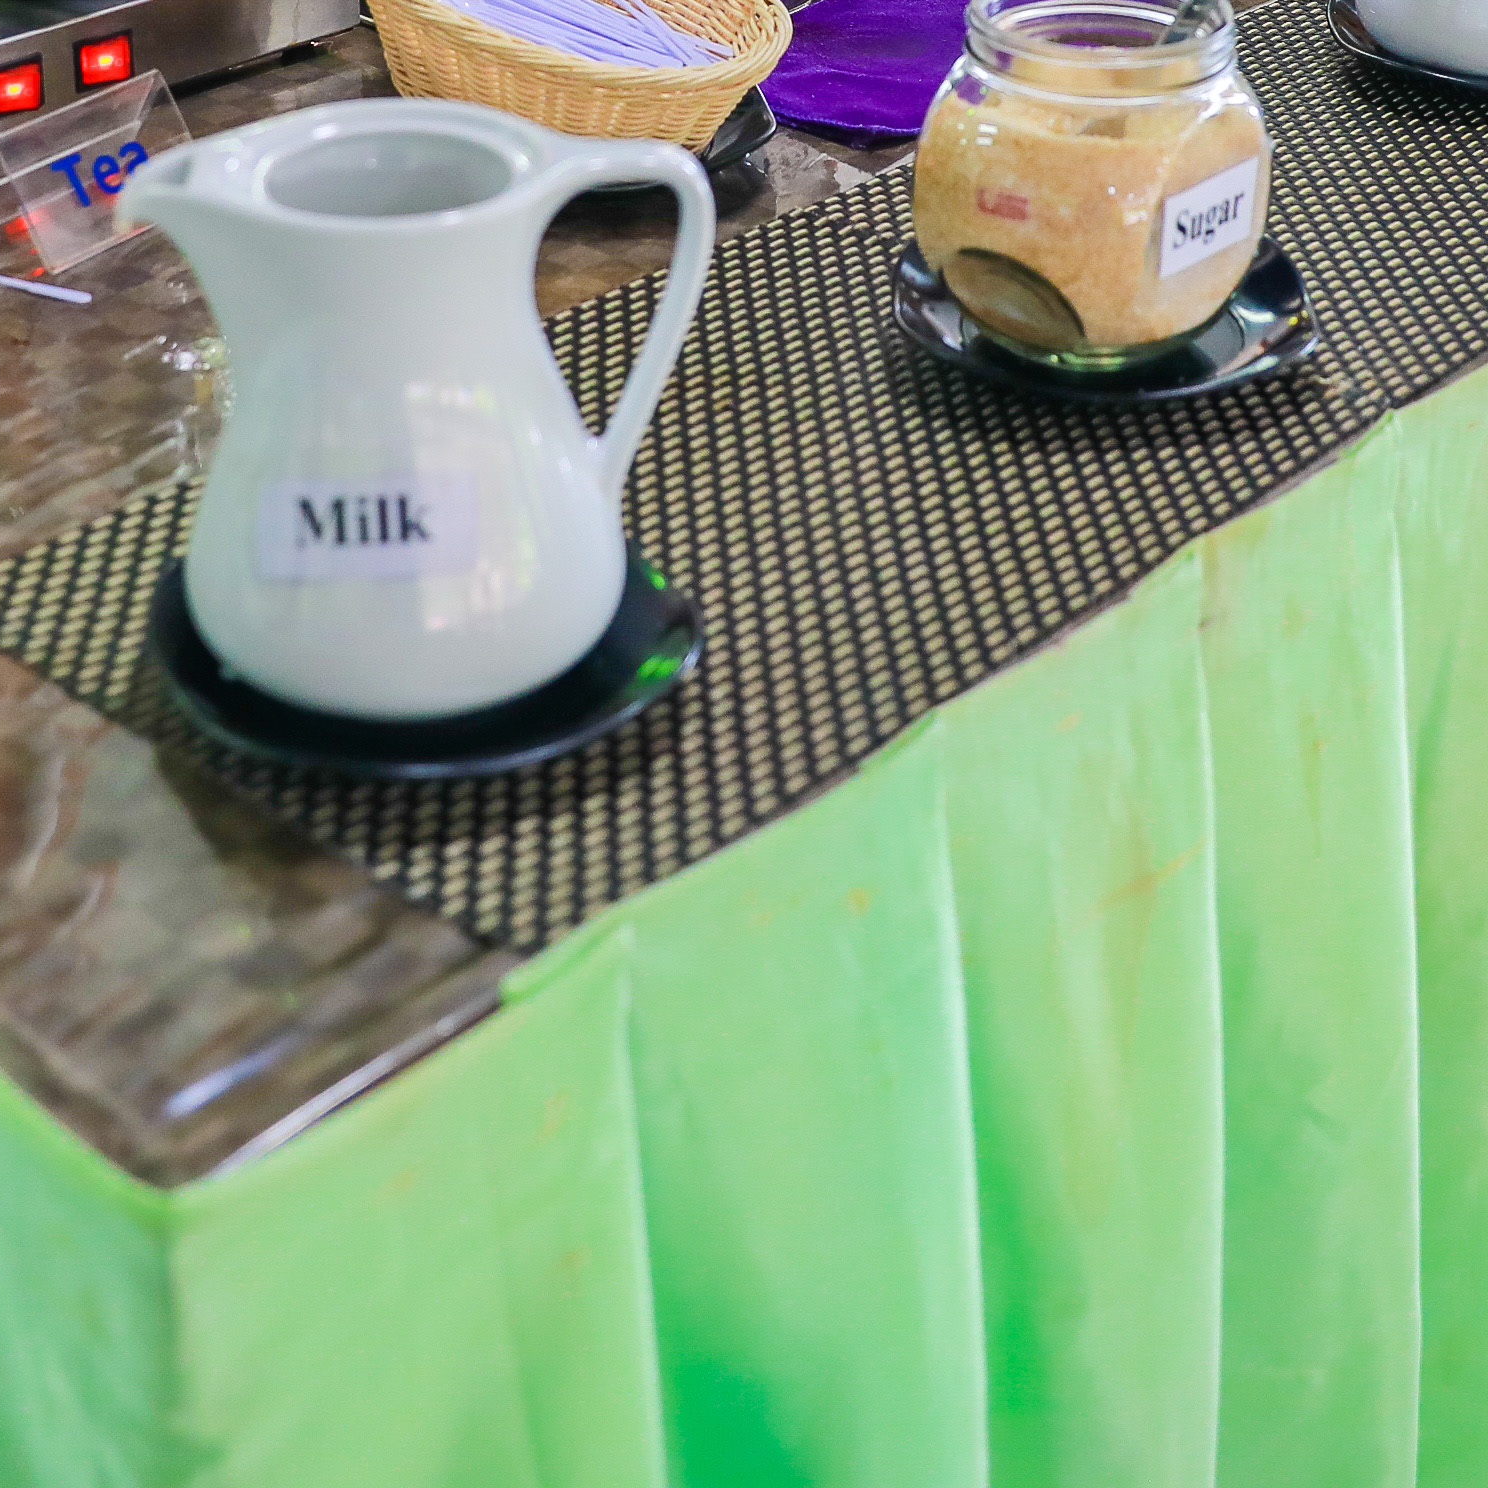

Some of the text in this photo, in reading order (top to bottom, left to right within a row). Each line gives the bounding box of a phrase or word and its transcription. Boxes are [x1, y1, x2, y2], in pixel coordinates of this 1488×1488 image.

[51, 140, 149, 207] Tea
[1172, 192, 1245, 249] Sugar
[294, 494, 432, 549] Milk
